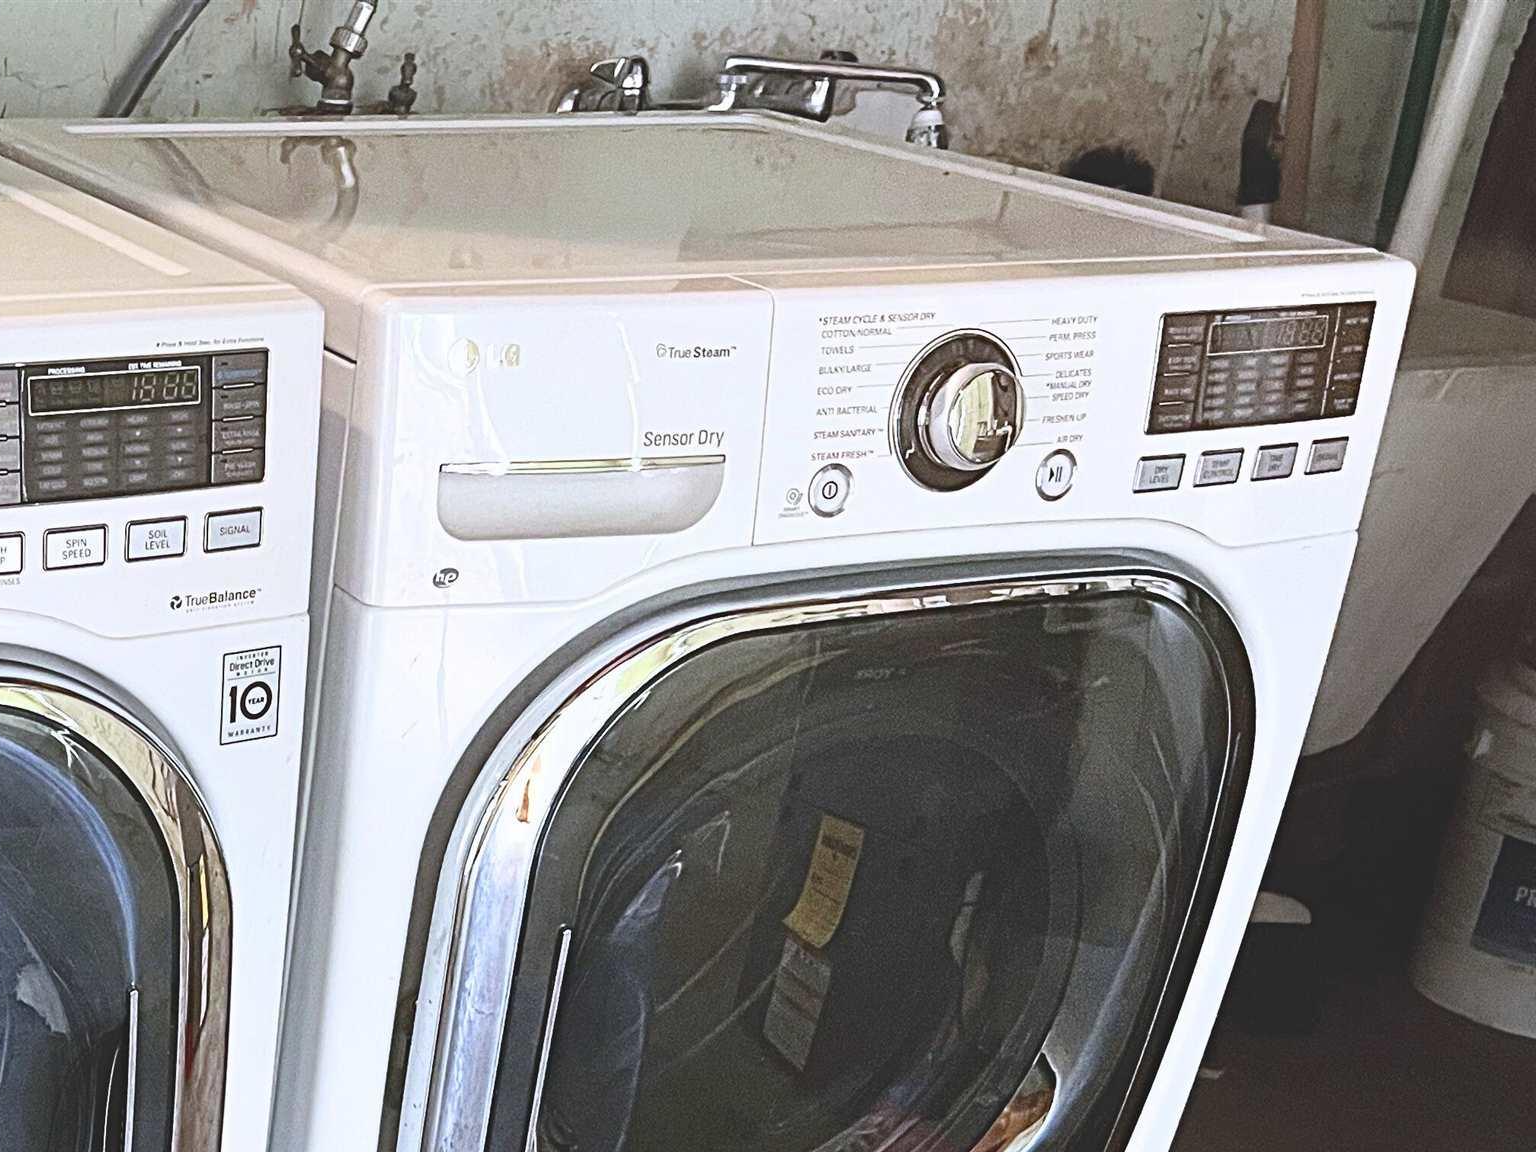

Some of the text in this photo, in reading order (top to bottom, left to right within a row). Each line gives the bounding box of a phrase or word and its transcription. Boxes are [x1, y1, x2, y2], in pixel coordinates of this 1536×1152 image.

[644, 429, 724, 447] Sensor Dry
[148, 529, 167, 539] SOIL
[219, 526, 250, 536] SIGNAL
[66, 539, 87, 548] SPIN
[145, 540, 170, 551] LEVEL
[62, 549, 92, 560] SPEED
[230, 661, 253, 672] Direct
[254, 658, 274, 668] Drive
[229, 681, 273, 724] 10
